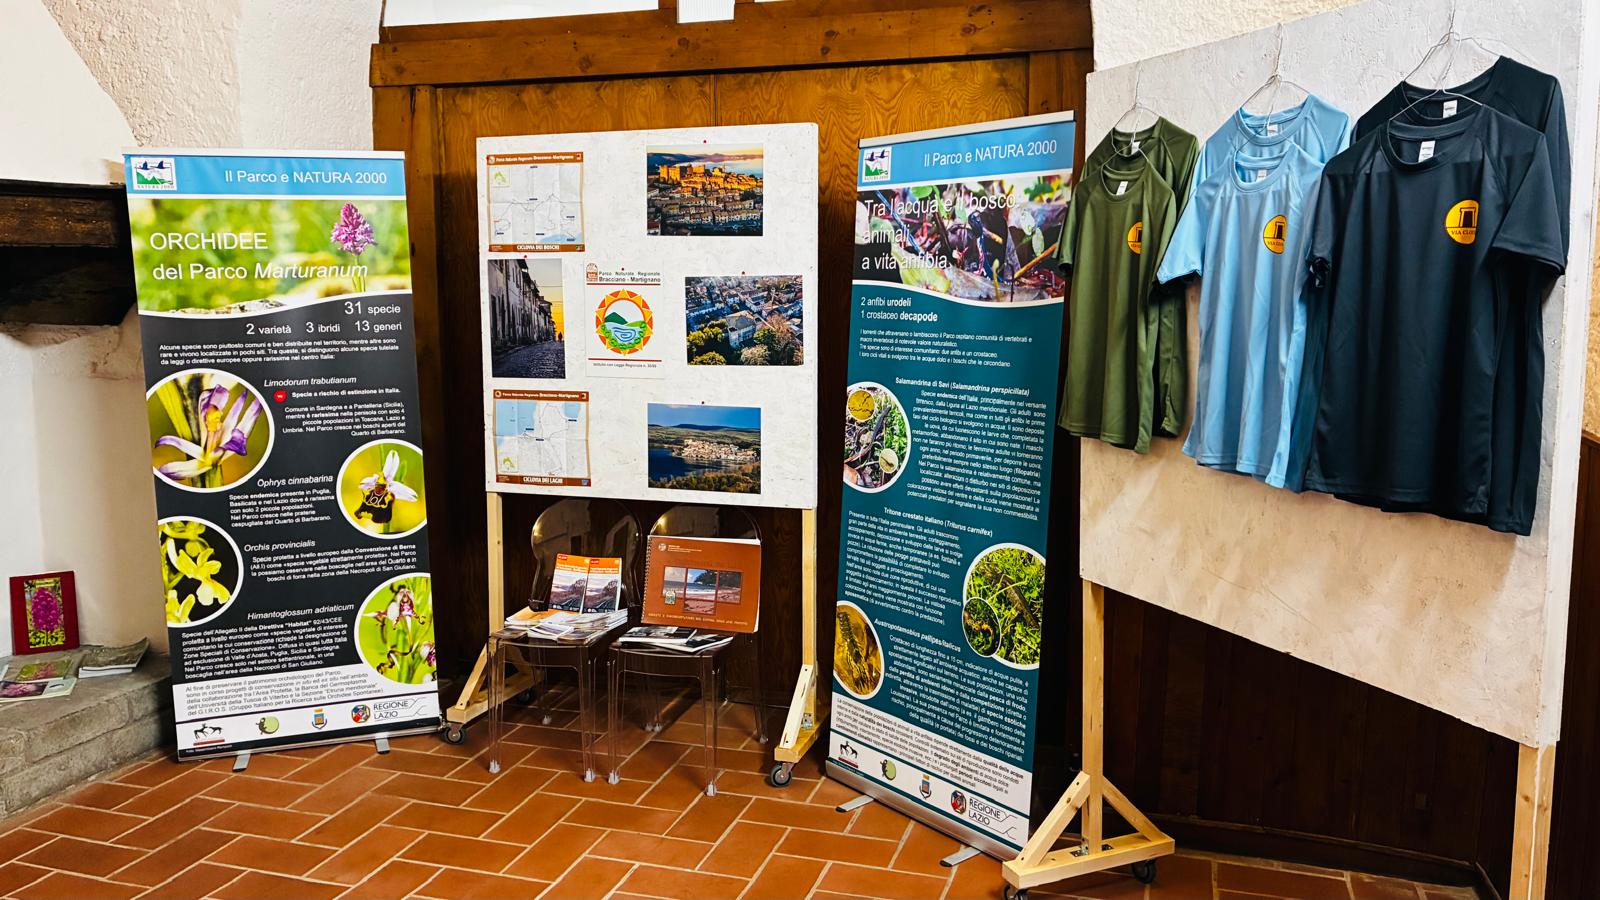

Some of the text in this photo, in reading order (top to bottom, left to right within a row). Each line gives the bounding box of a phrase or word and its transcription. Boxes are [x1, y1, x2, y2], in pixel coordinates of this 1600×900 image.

[924, 139, 1057, 167] Il Parco e NATURA 2000
[225, 170, 387, 184] Il Parco e NATURA 2000
[865, 200, 885, 216] Tra
[150, 233, 268, 250] ORCHIDEE
[862, 257, 870, 270] a
[874, 252, 897, 270] vita
[153, 262, 368, 280] del Parco Marturanum
[344, 300, 401, 316] 31 specie
[860, 297, 912, 307] 2 anfibi urodeli
[861, 310, 938, 323] 1 crostaceo decapode
[246, 318, 401, 334] 2 varietà 3 ibridi 13 generi
[374, 701, 408, 710] REGIONE
[374, 711, 398, 719] LAZIO
[970, 799, 1000, 819] REGIONE
[969, 810, 990, 825] LAZIO
